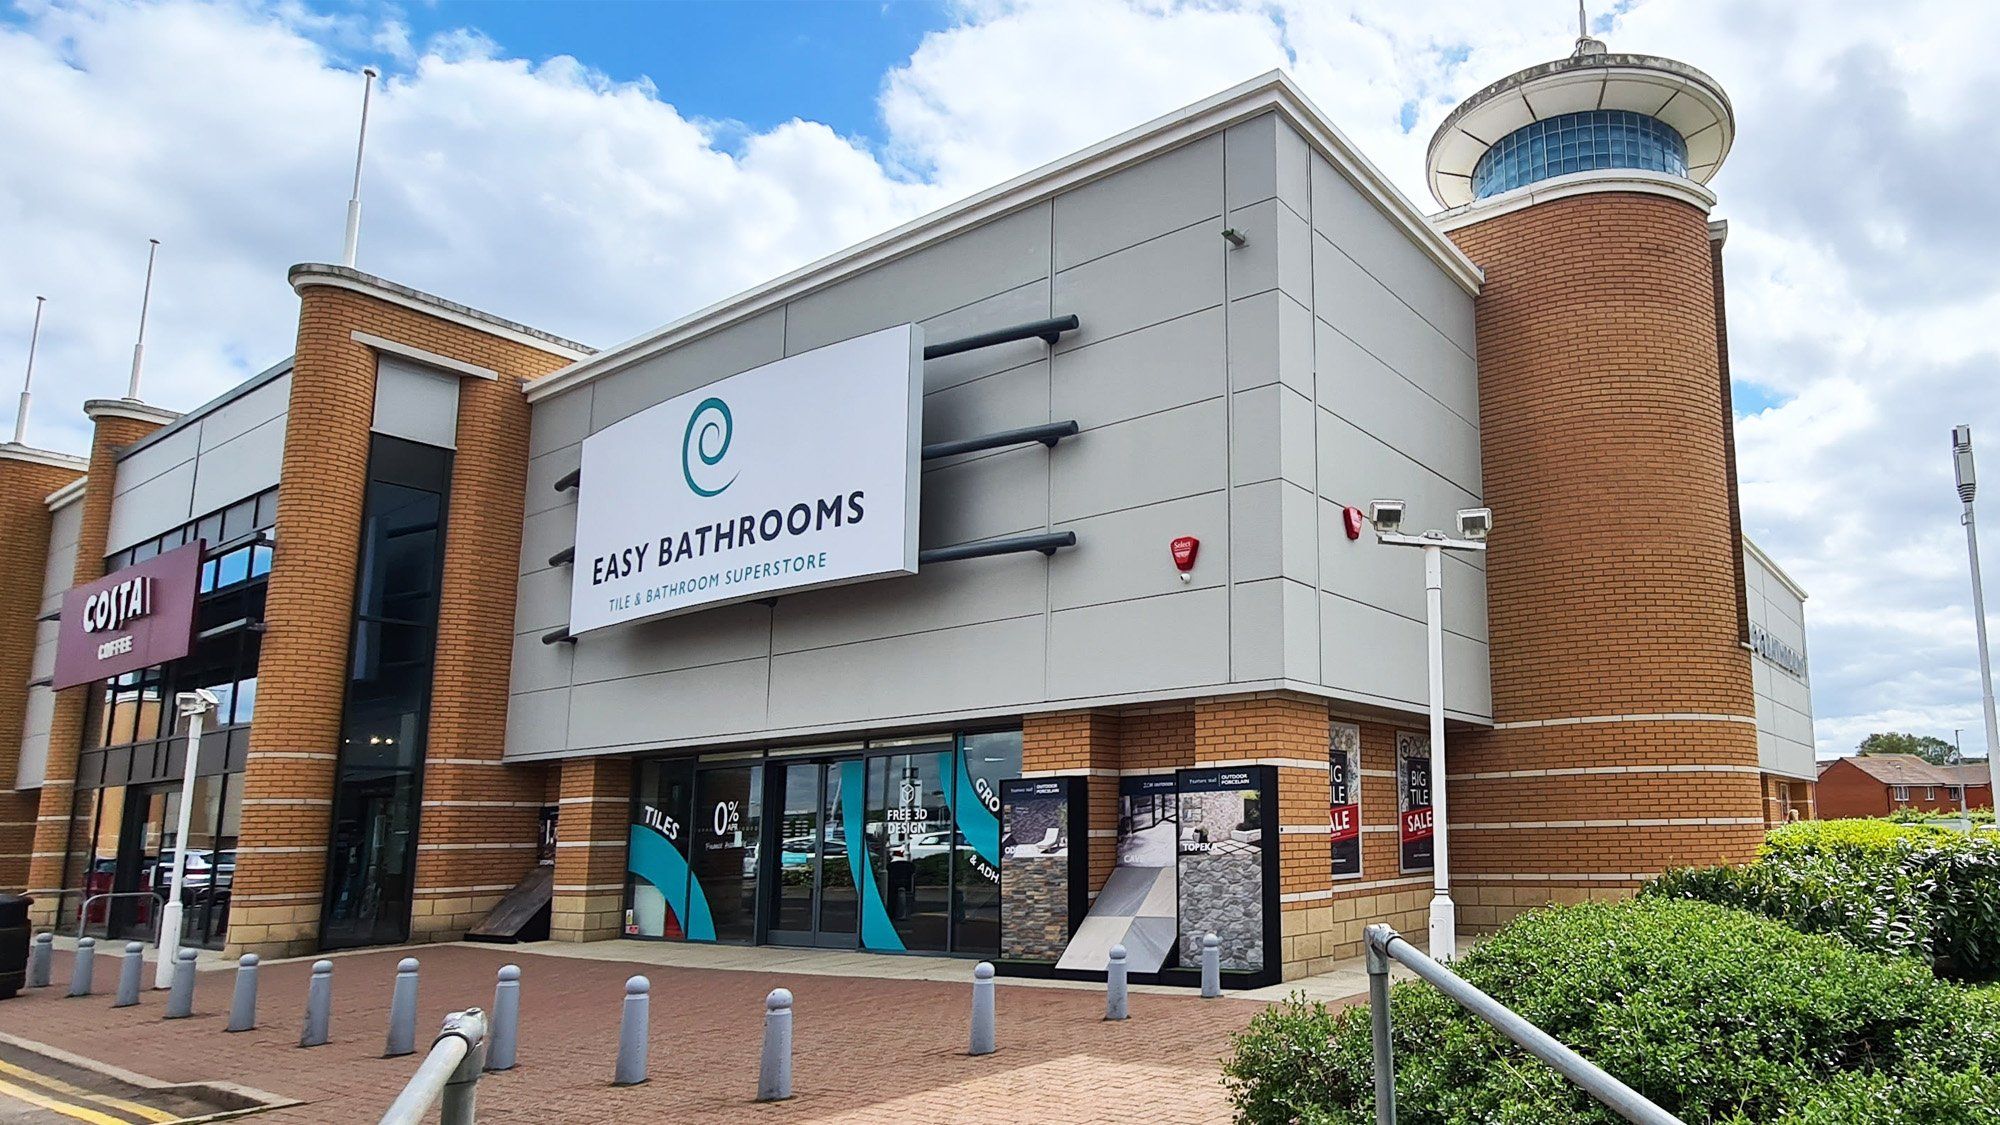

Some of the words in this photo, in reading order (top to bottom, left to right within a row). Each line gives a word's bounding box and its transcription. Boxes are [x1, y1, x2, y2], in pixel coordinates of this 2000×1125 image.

[592, 542, 650, 586] EASY
[658, 490, 864, 567] BATHROOMS
[1173, 540, 1192, 548] Select
[609, 594, 631, 612] TILE
[634, 592, 641, 606] &
[646, 573, 719, 603] BATHROOM
[725, 552, 827, 585] SUPERSTORE
[83, 576, 150, 633] COSTA
[98, 635, 133, 660] COFFEE
[1330, 764, 1343, 783] IG
[1411, 770, 1426, 786] BIG
[975, 778, 1000, 812] GRO
[1330, 786, 1345, 804] ILE
[1410, 788, 1429, 805] TILE
[644, 805, 680, 840] TILES
[714, 800, 739, 836] 0%
[887, 809, 912, 820] FREE
[914, 808, 928, 820] 3D
[1330, 810, 1350, 832] ALE
[1407, 811, 1433, 832] SALE
[887, 822, 927, 834] DESIGN
[1182, 842, 1219, 852] TOPEKA
[969, 854, 978, 867] &
[977, 862, 1000, 885] ADH
